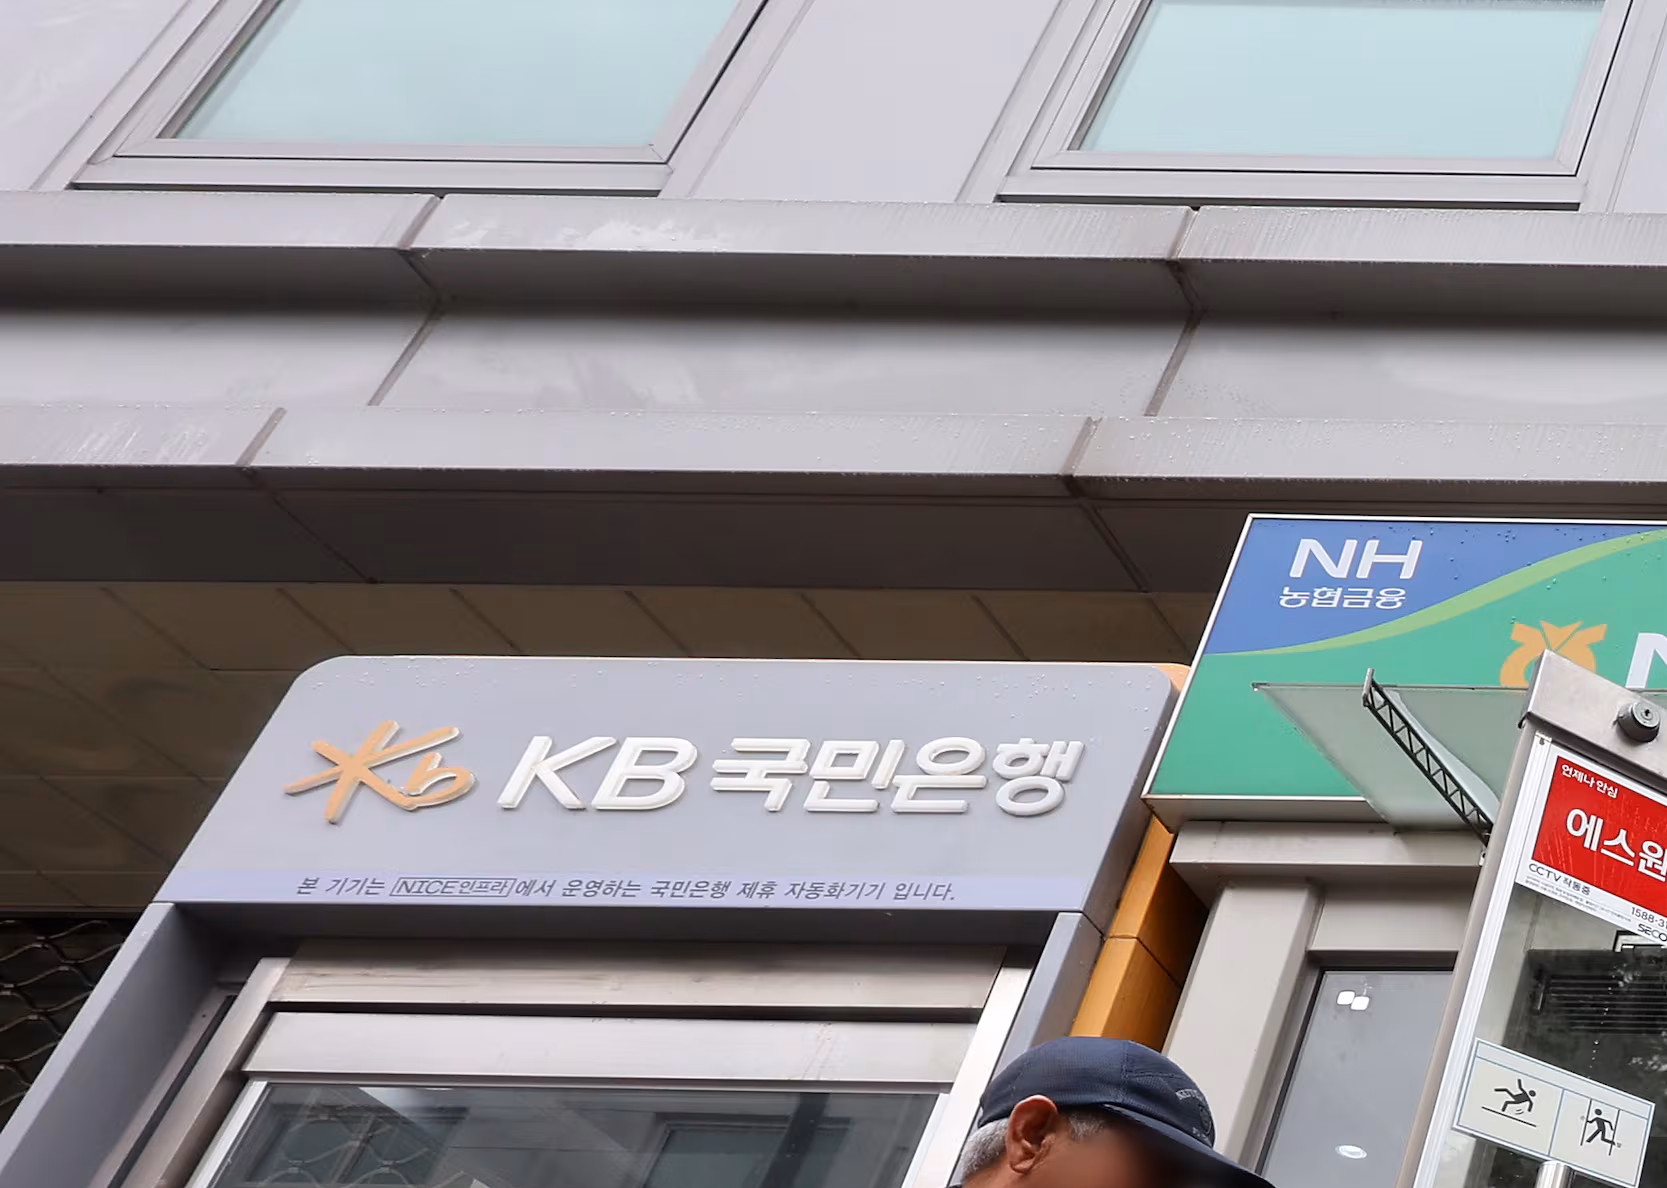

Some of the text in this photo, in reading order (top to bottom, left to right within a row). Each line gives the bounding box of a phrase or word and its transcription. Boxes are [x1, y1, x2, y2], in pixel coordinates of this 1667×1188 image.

[1289, 538, 1423, 579] NH
[1279, 586, 1407, 610] 농협금융
[709, 736, 1085, 818] 국민은행
[1561, 763, 1619, 799] 언제나 안심
[297, 877, 319, 896] 본
[325, 877, 386, 897] 기기는
[561, 878, 641, 898] 운영하는
[649, 879, 731, 899] 국민은행
[736, 880, 776, 900] 제휴
[784, 880, 885, 900] 자동화기기
[893, 881, 955, 902] 입니다.
[1528, 863, 1591, 896] CCTV 작동중
